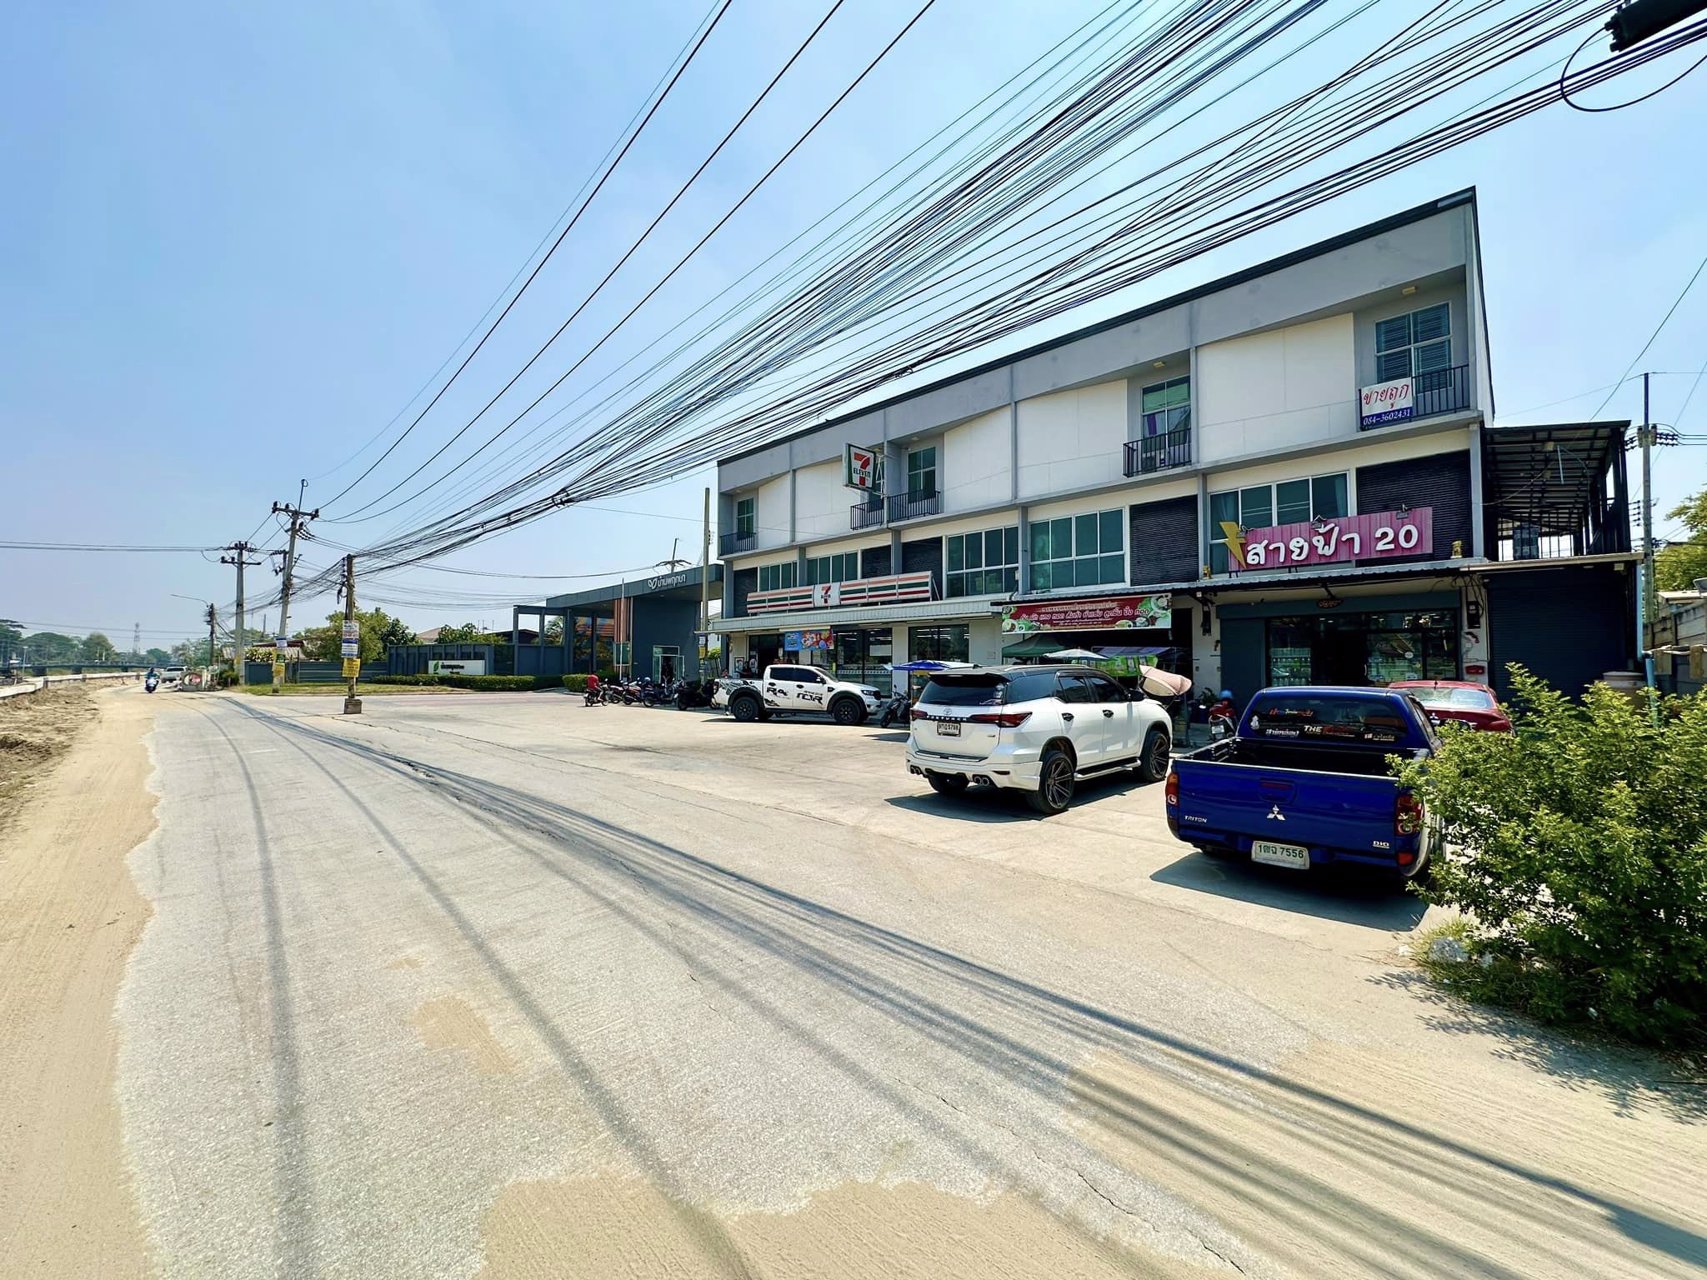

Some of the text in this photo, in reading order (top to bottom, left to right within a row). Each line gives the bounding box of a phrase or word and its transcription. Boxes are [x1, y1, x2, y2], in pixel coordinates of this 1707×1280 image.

[1363, 384, 1409, 409] ขายถูก
[1363, 408, 1411, 425] 084-3602431
[1246, 523, 1419, 565] สายฟ้า 20
[1303, 724, 1323, 733] THE
[1184, 815, 1208, 824] TRITON
[1279, 846, 1304, 859] 7556
